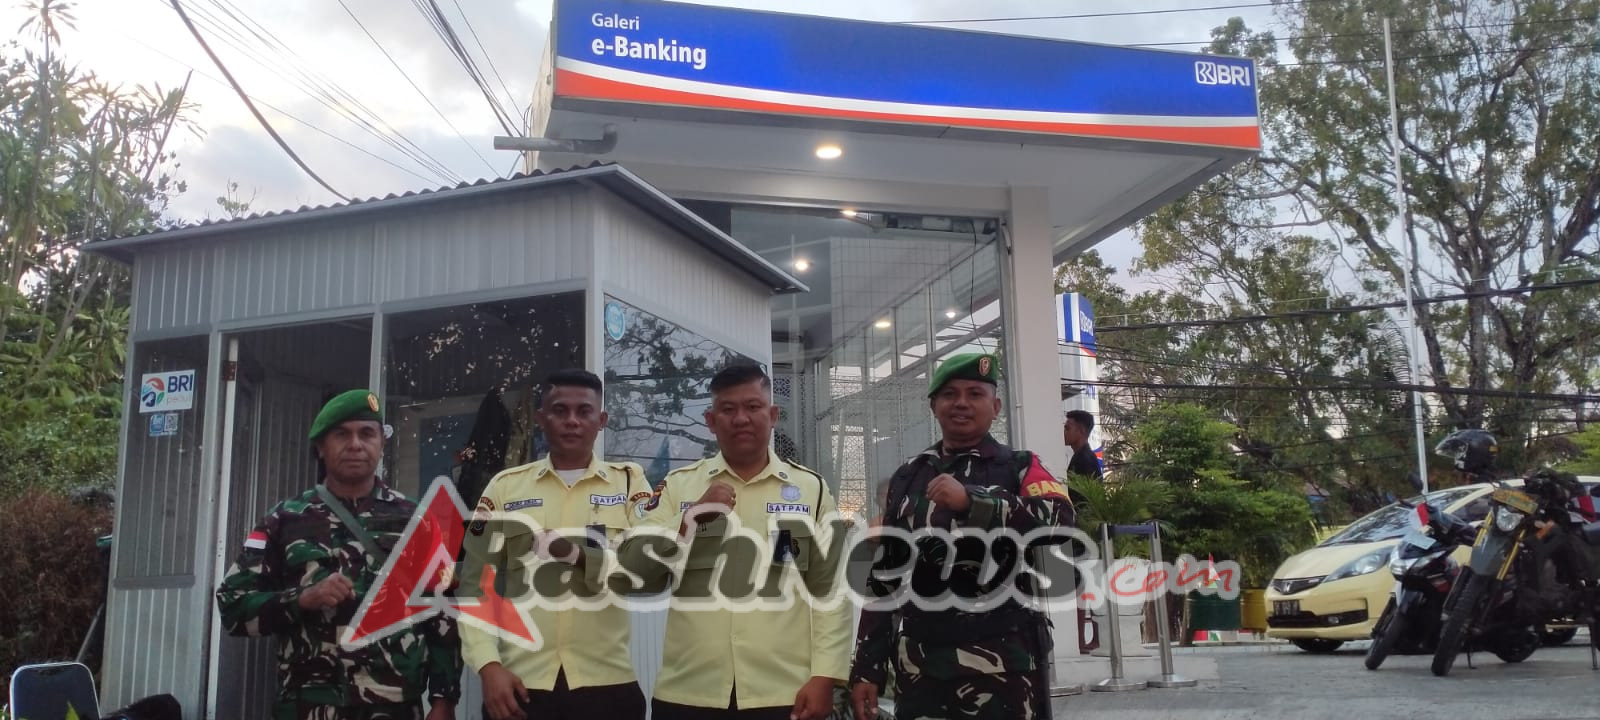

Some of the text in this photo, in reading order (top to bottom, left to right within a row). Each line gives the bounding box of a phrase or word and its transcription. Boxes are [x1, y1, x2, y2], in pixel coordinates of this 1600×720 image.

[591, 12, 640, 31] Galeri
[591, 35, 707, 70] e-Banking
[1217, 64, 1251, 87] BRI
[167, 374, 194, 393] BRI
[768, 504, 809, 514] SATPAM
